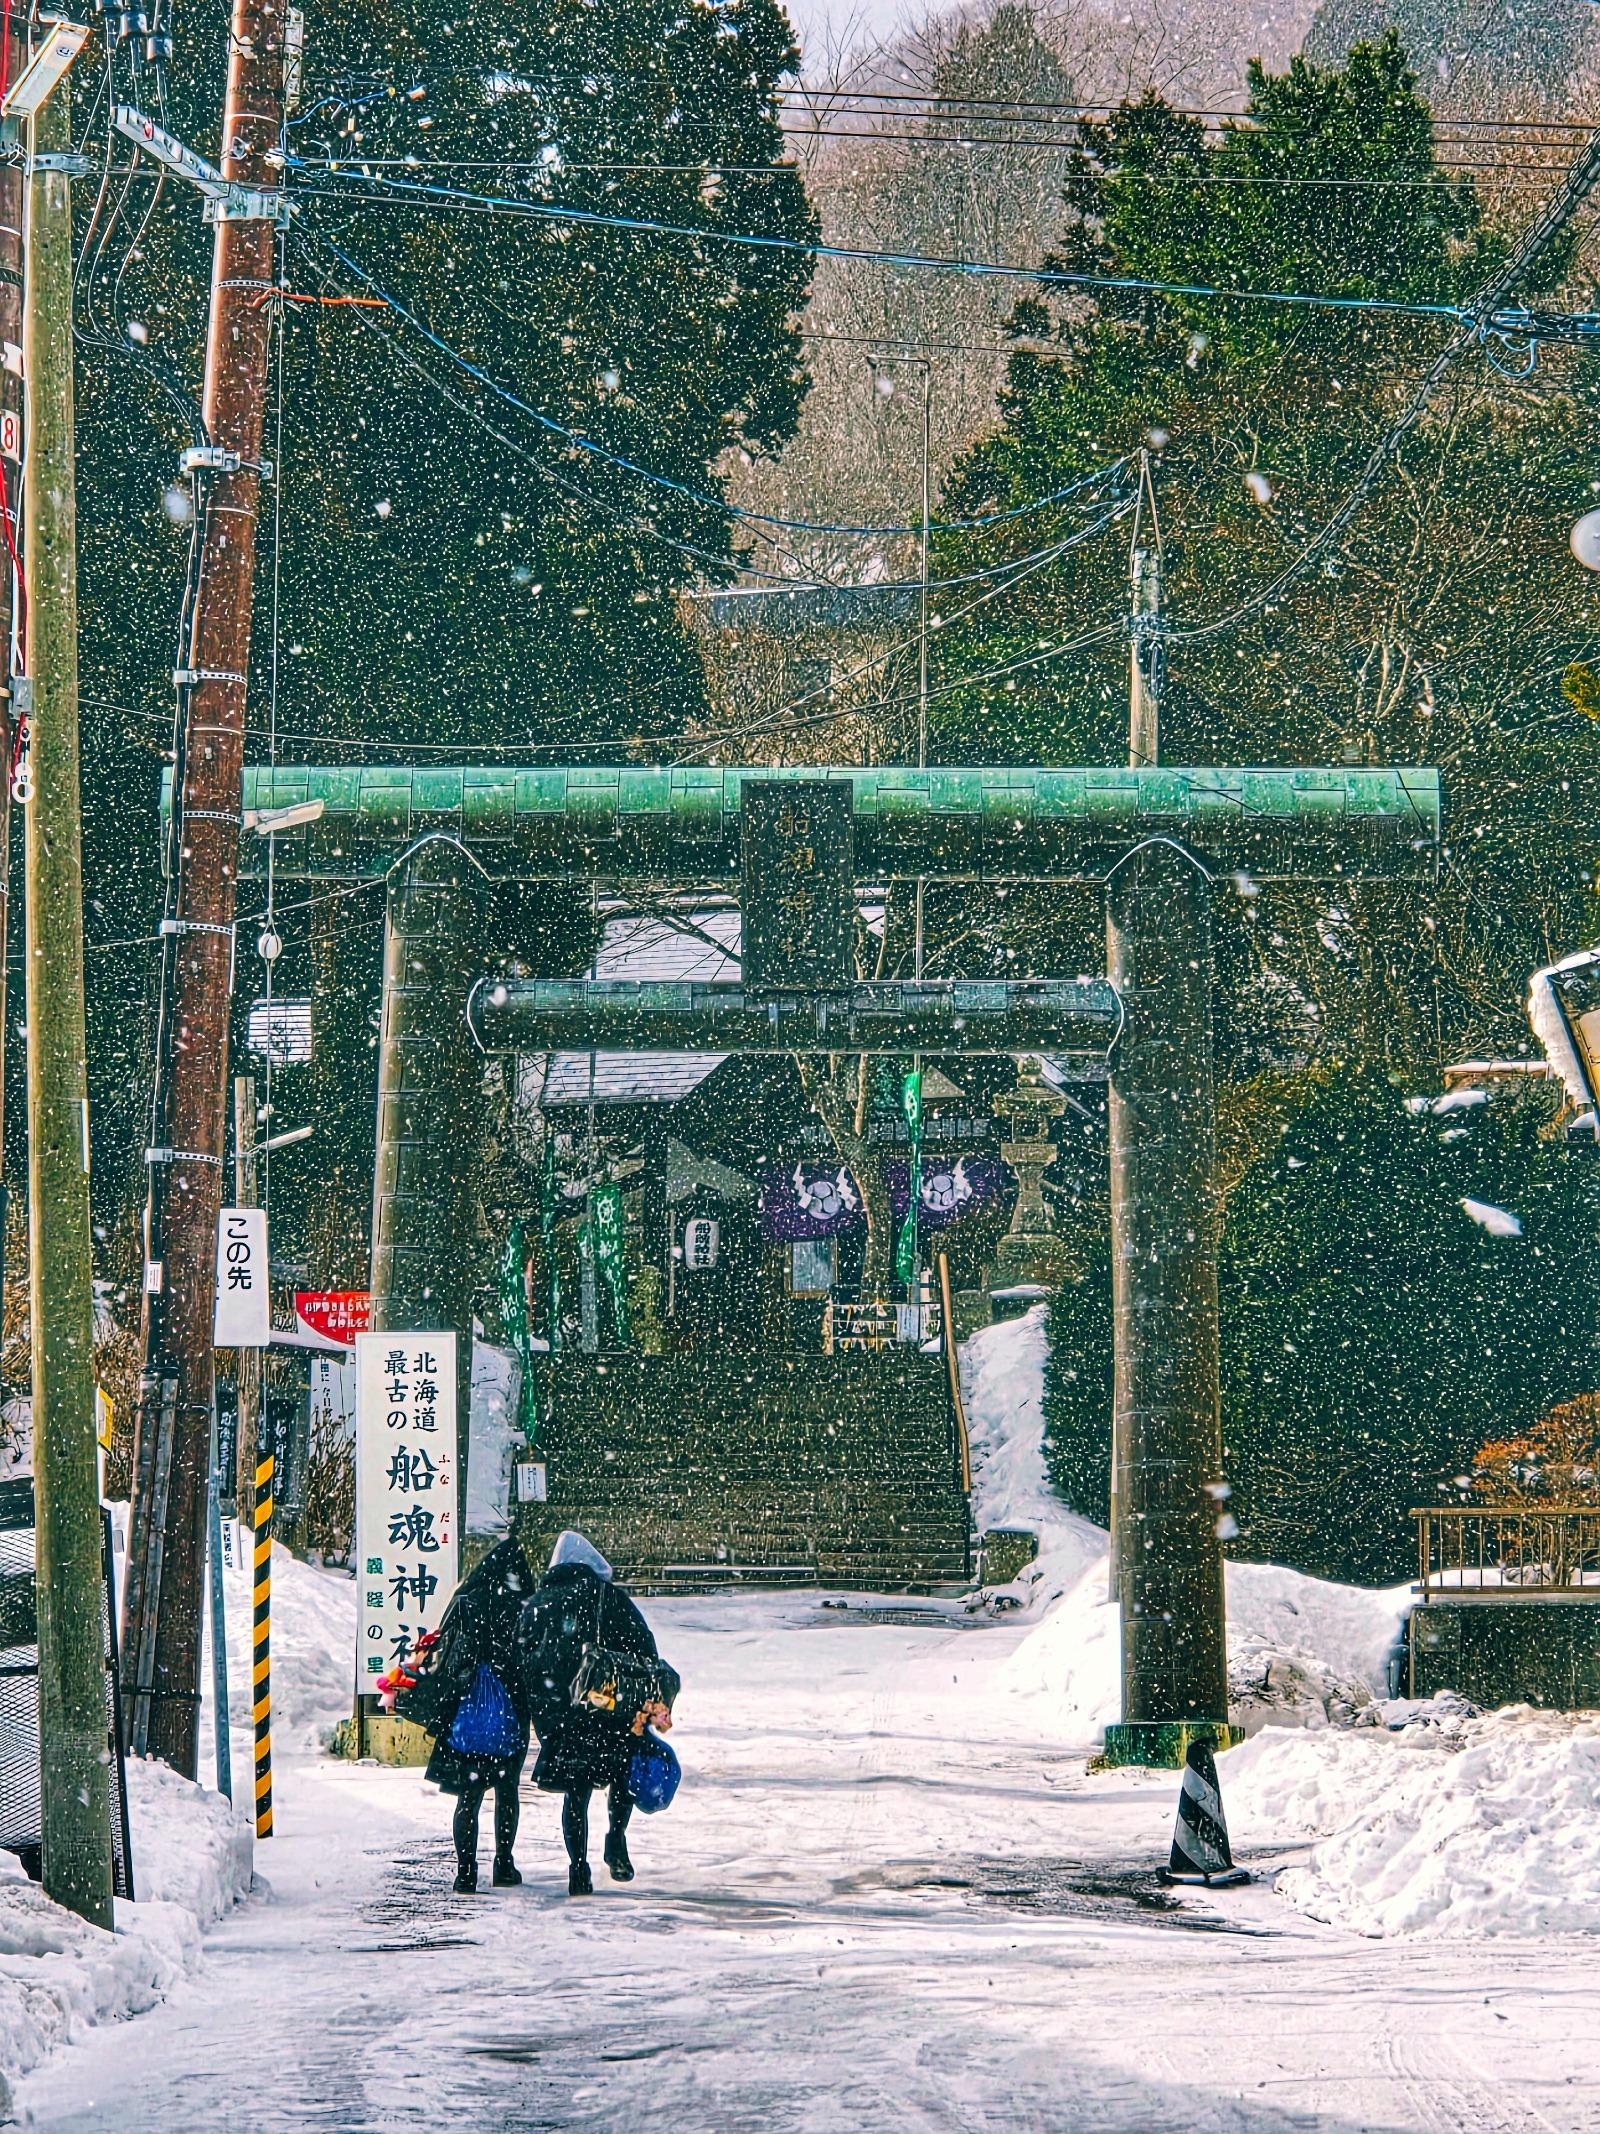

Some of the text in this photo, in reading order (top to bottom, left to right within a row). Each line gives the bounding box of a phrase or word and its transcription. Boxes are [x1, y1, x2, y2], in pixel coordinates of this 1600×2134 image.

[226, 1217, 252, 1290] この先
[384, 1350, 410, 1430] 最古の
[412, 1351, 440, 1433] 北海道
